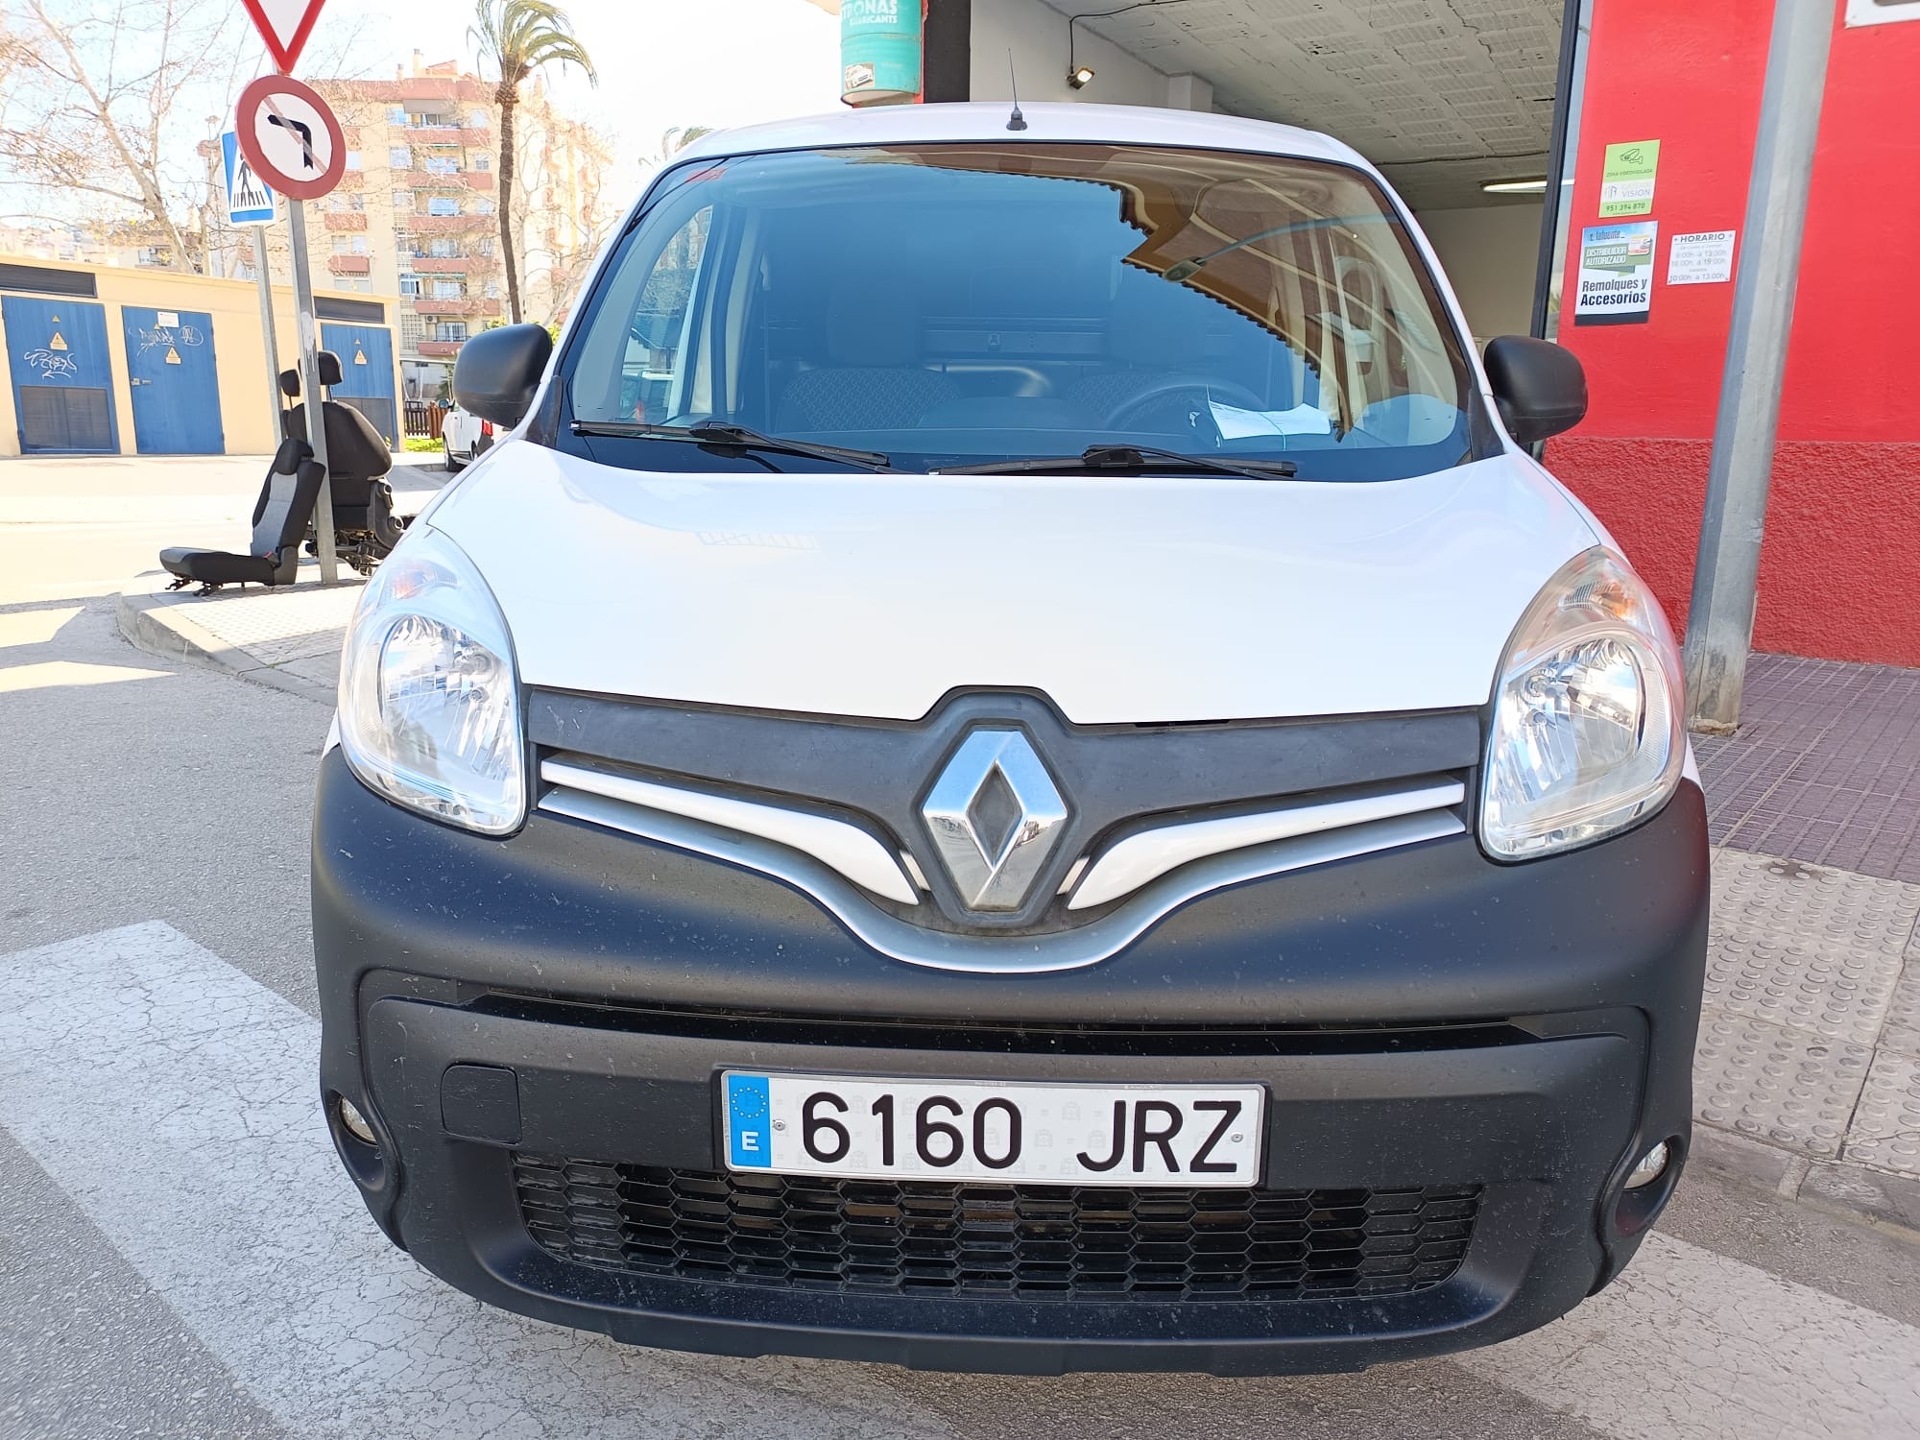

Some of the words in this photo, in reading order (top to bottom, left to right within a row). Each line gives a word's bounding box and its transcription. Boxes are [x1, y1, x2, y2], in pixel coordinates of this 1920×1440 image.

[1622, 188, 1651, 198] VISION
[1680, 233, 1725, 243] HORARIO
[1586, 246, 1627, 257] DISTRIBUIDOR
[1585, 255, 1626, 266] AUTORIZADO
[1582, 279, 1639, 293] Remolques
[1641, 278, 1648, 290] y
[1580, 291, 1647, 307] Accesorios
[801, 1091, 1022, 1169] 6160
[1076, 1100, 1242, 1174] JRZ
[741, 1131, 760, 1151] E
